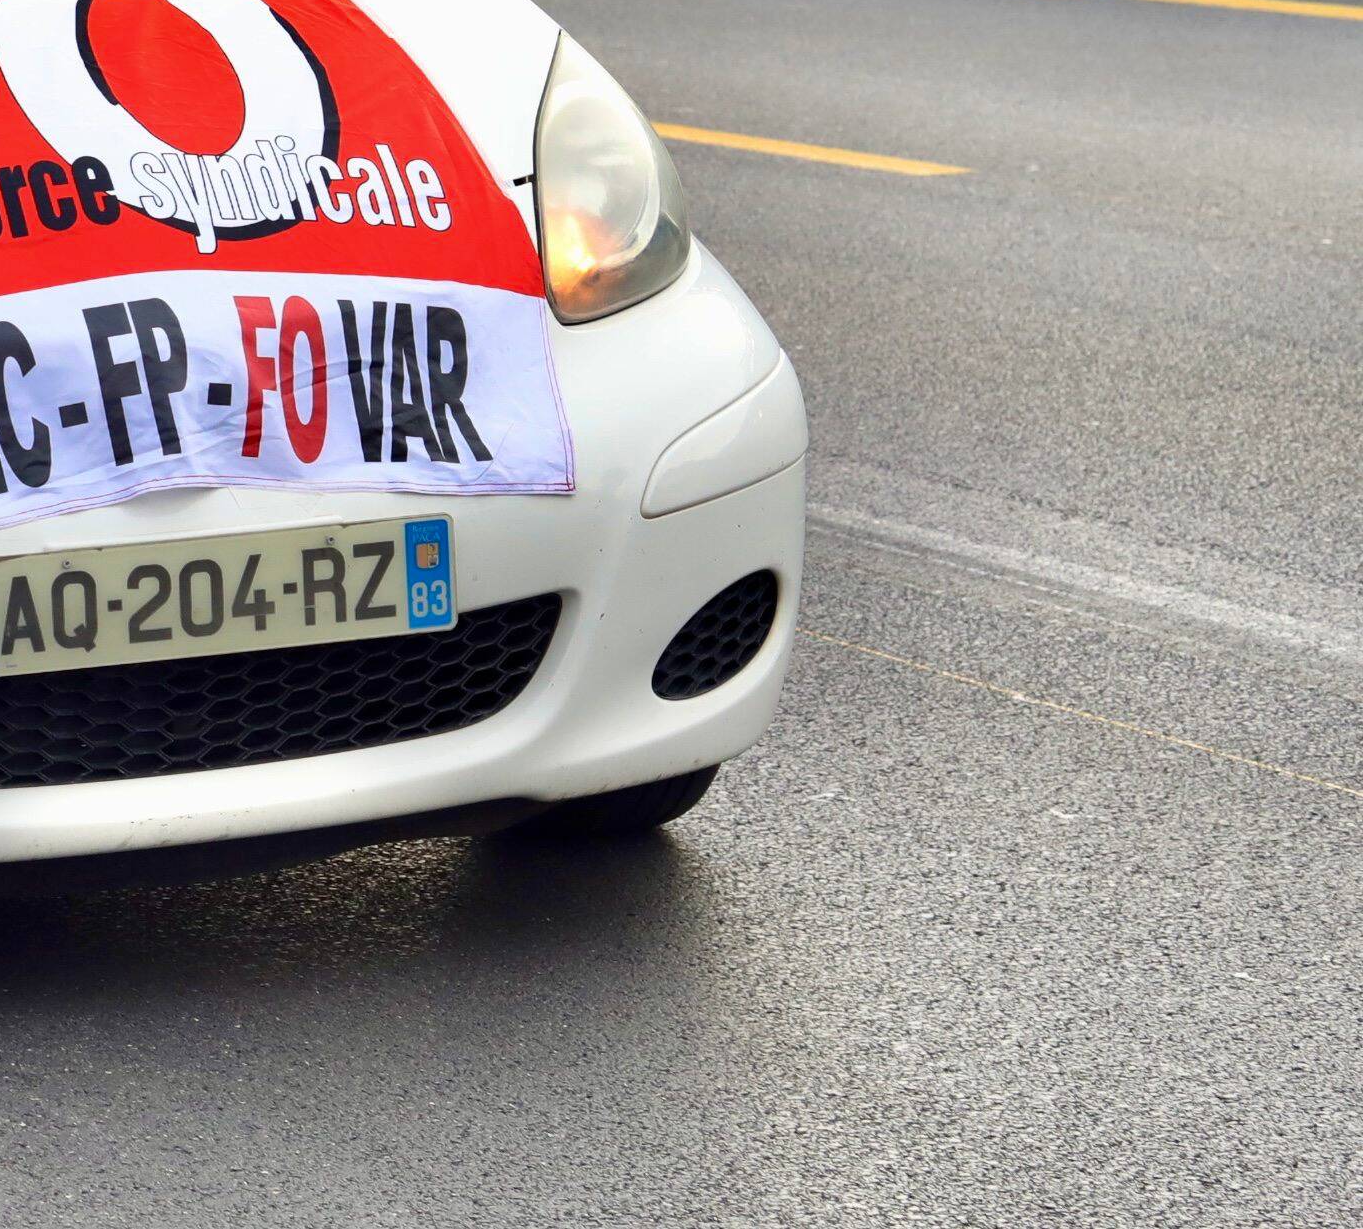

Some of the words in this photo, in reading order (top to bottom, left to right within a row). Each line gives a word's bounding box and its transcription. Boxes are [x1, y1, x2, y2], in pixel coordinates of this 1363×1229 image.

[129, 135, 453, 254] syndicale
[338, 298, 494, 464] VAR
[0, 540, 398, 657] AQ-204-RZ
[411, 579, 449, 618] 83
